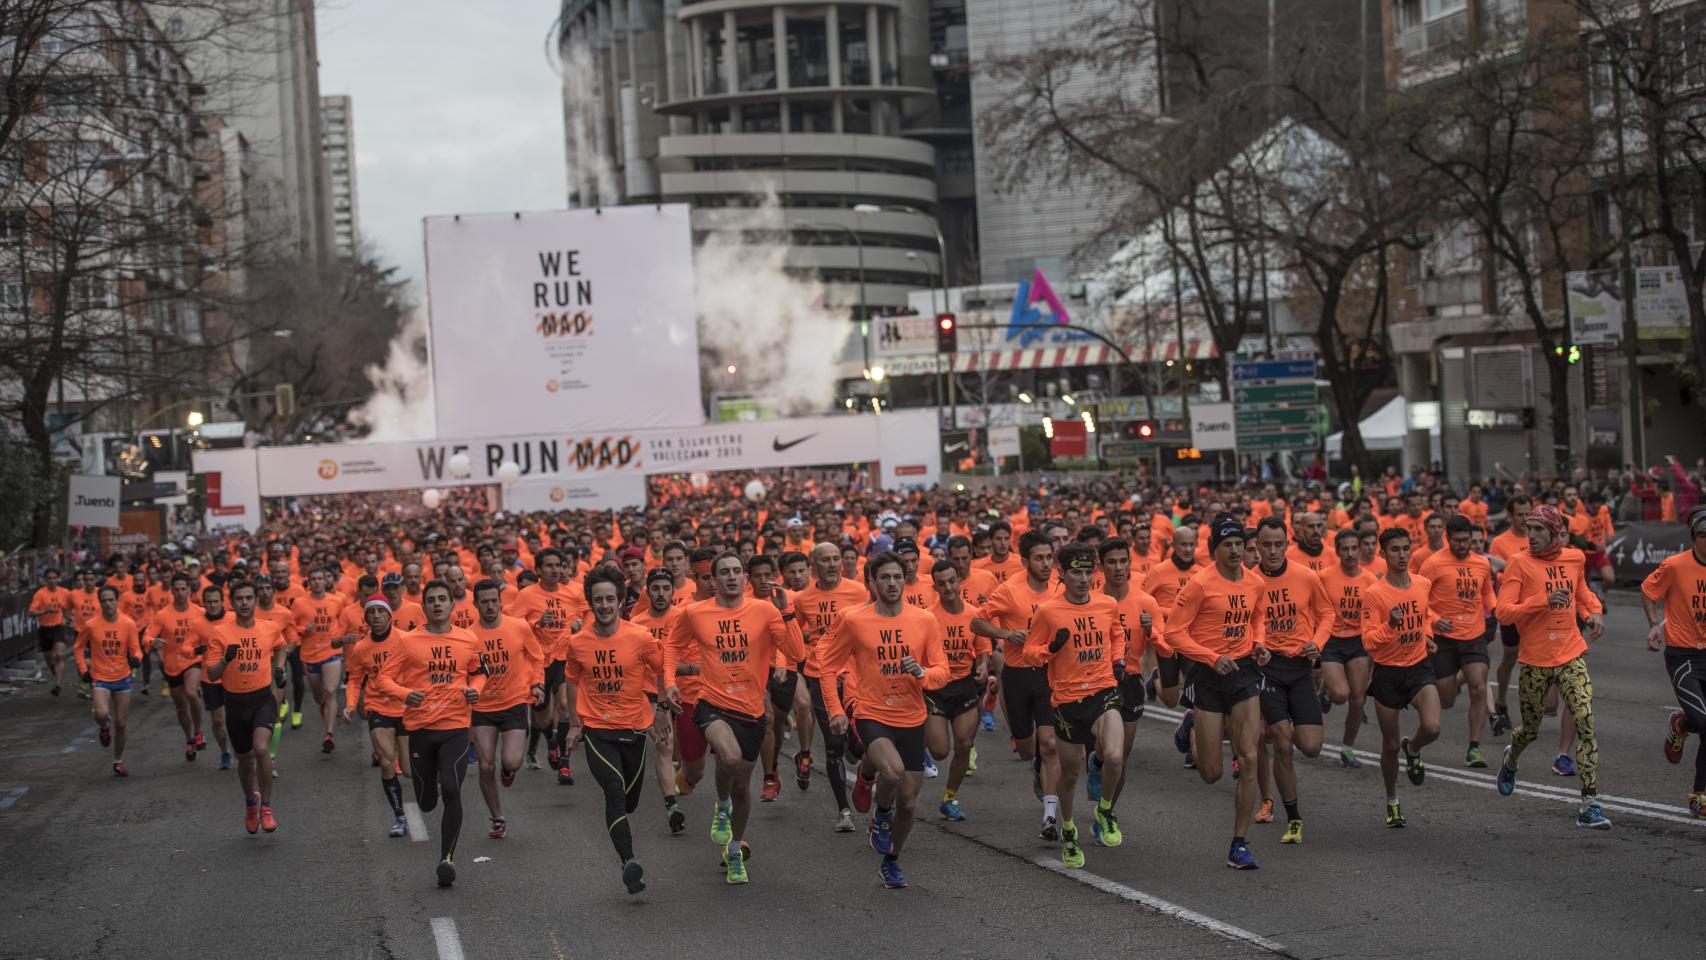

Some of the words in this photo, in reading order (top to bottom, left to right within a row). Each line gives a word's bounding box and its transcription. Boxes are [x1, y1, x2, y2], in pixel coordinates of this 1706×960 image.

[539, 251, 581, 277] WE
[534, 280, 592, 308] RUN
[542, 312, 587, 336] MAD
[650, 439, 671, 449] SAN
[680, 433, 742, 448] SILVESTRE
[486, 439, 559, 477] RUN
[576, 439, 633, 468] MAD
[1645, 543, 1684, 563] Sant
[1309, 561, 1322, 570] WE
[1456, 567, 1473, 577] WE
[1546, 565, 1567, 579] WE
[1179, 577, 1190, 587] W
[1456, 579, 1478, 589] RUN
[1268, 588, 1290, 603] WE
[1344, 586, 1359, 597] WE
[546, 599, 562, 609] WE
[907, 594, 924, 605] WE
[1228, 595, 1247, 608] WE
[1340, 598, 1362, 609] RUN
[456, 609, 470, 618] WE
[819, 601, 836, 613] WE
[1267, 603, 1296, 619] RUN
[1399, 600, 1419, 615] WE
[552, 610, 567, 619] UN
[816, 614, 837, 626] RU
[1224, 610, 1250, 624] RUN
[718, 619, 742, 634] WE
[1074, 616, 1097, 631] WE
[1270, 619, 1293, 631] MAD
[1397, 615, 1422, 631] RUN
[105, 631, 118, 639] WE
[880, 629, 903, 643] WE
[947, 626, 964, 638] WE
[102, 640, 120, 648] RUN
[240, 638, 257, 648] WE
[485, 638, 504, 651] WE
[716, 634, 748, 649] RUN
[944, 639, 968, 650] RUN
[1073, 631, 1103, 648] RUN
[238, 650, 261, 660] RUN
[431, 646, 452, 659] WE
[484, 651, 509, 664] RUN
[595, 650, 616, 664] WE
[722, 651, 745, 663] MAD
[877, 645, 909, 660] RUN
[1079, 648, 1101, 662] MAD
[240, 663, 257, 672] MAD
[428, 660, 457, 672] RUN
[592, 665, 623, 679] RUN
[431, 673, 452, 684] MAD
[597, 681, 621, 692] MAD
